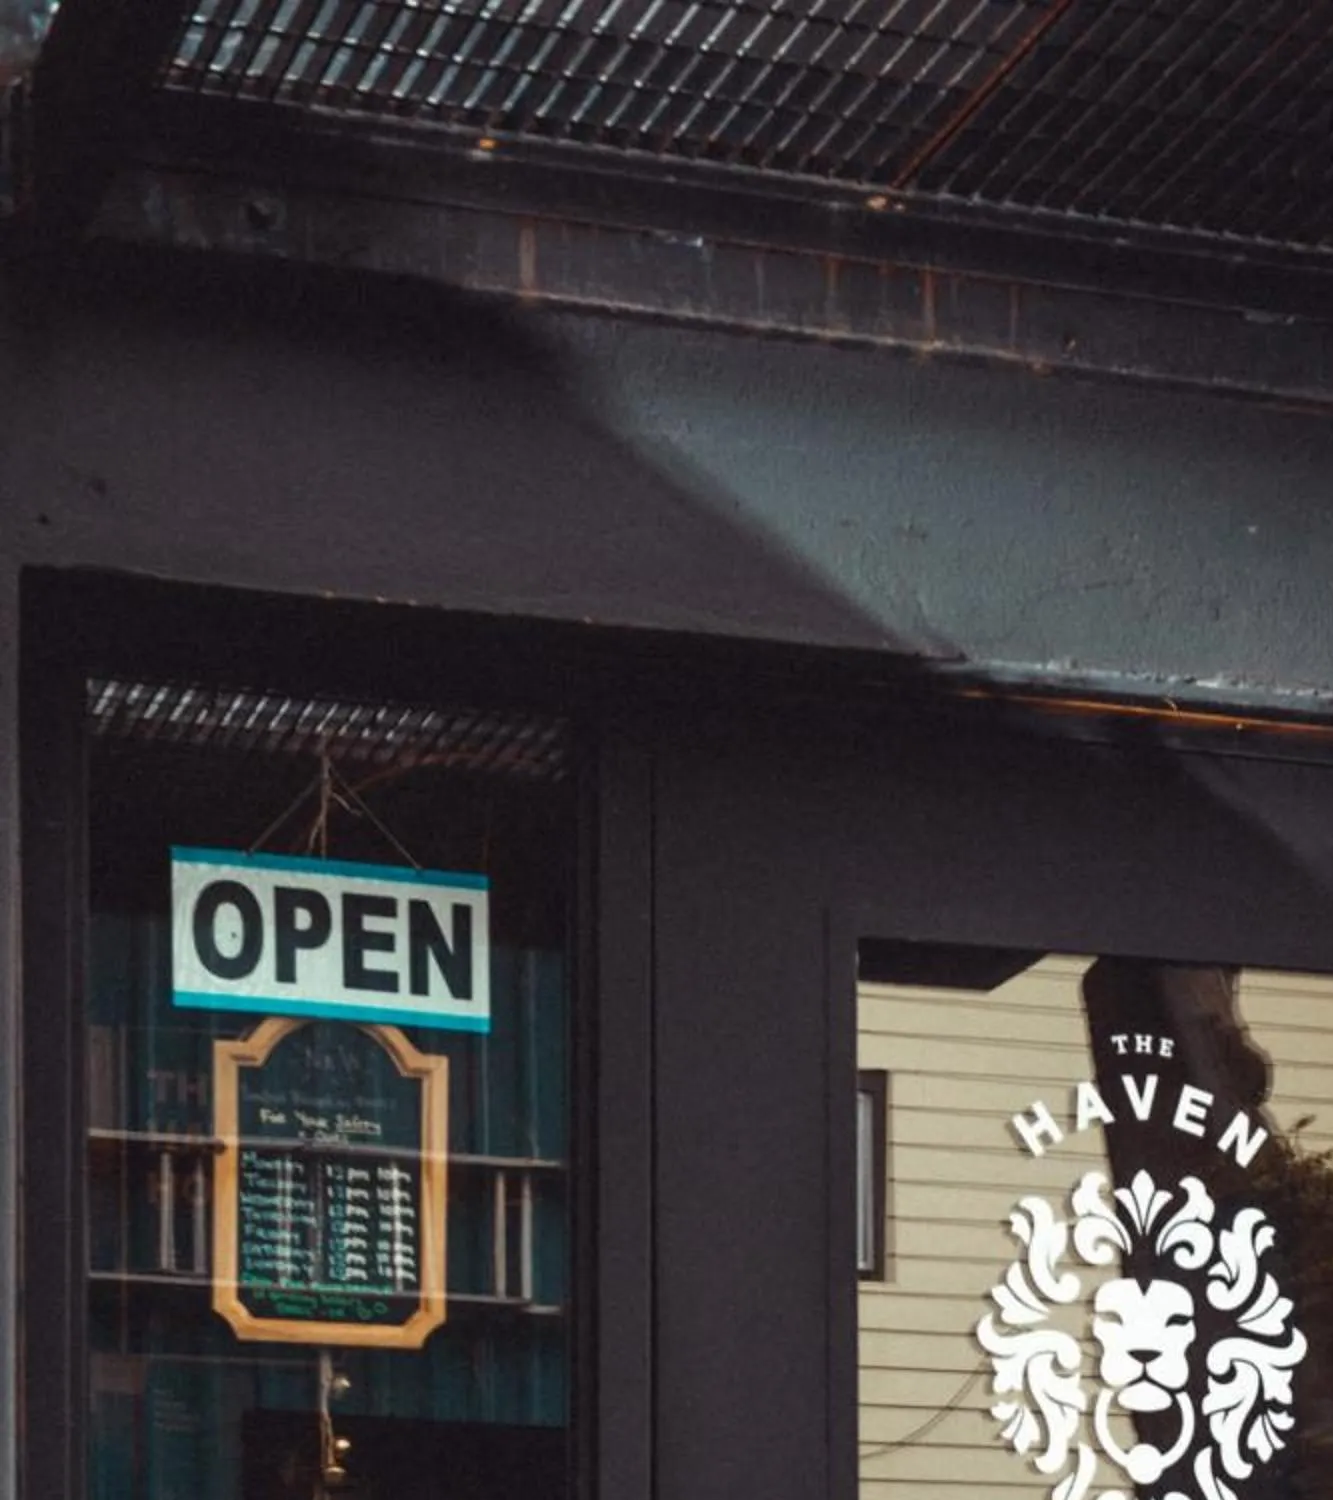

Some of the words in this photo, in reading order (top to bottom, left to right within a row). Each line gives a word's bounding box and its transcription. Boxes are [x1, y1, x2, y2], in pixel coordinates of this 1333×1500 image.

[191, 879, 474, 1001] OPEN
[1111, 1034, 1175, 1058] THE
[1012, 1074, 1267, 1168] HAVEN
